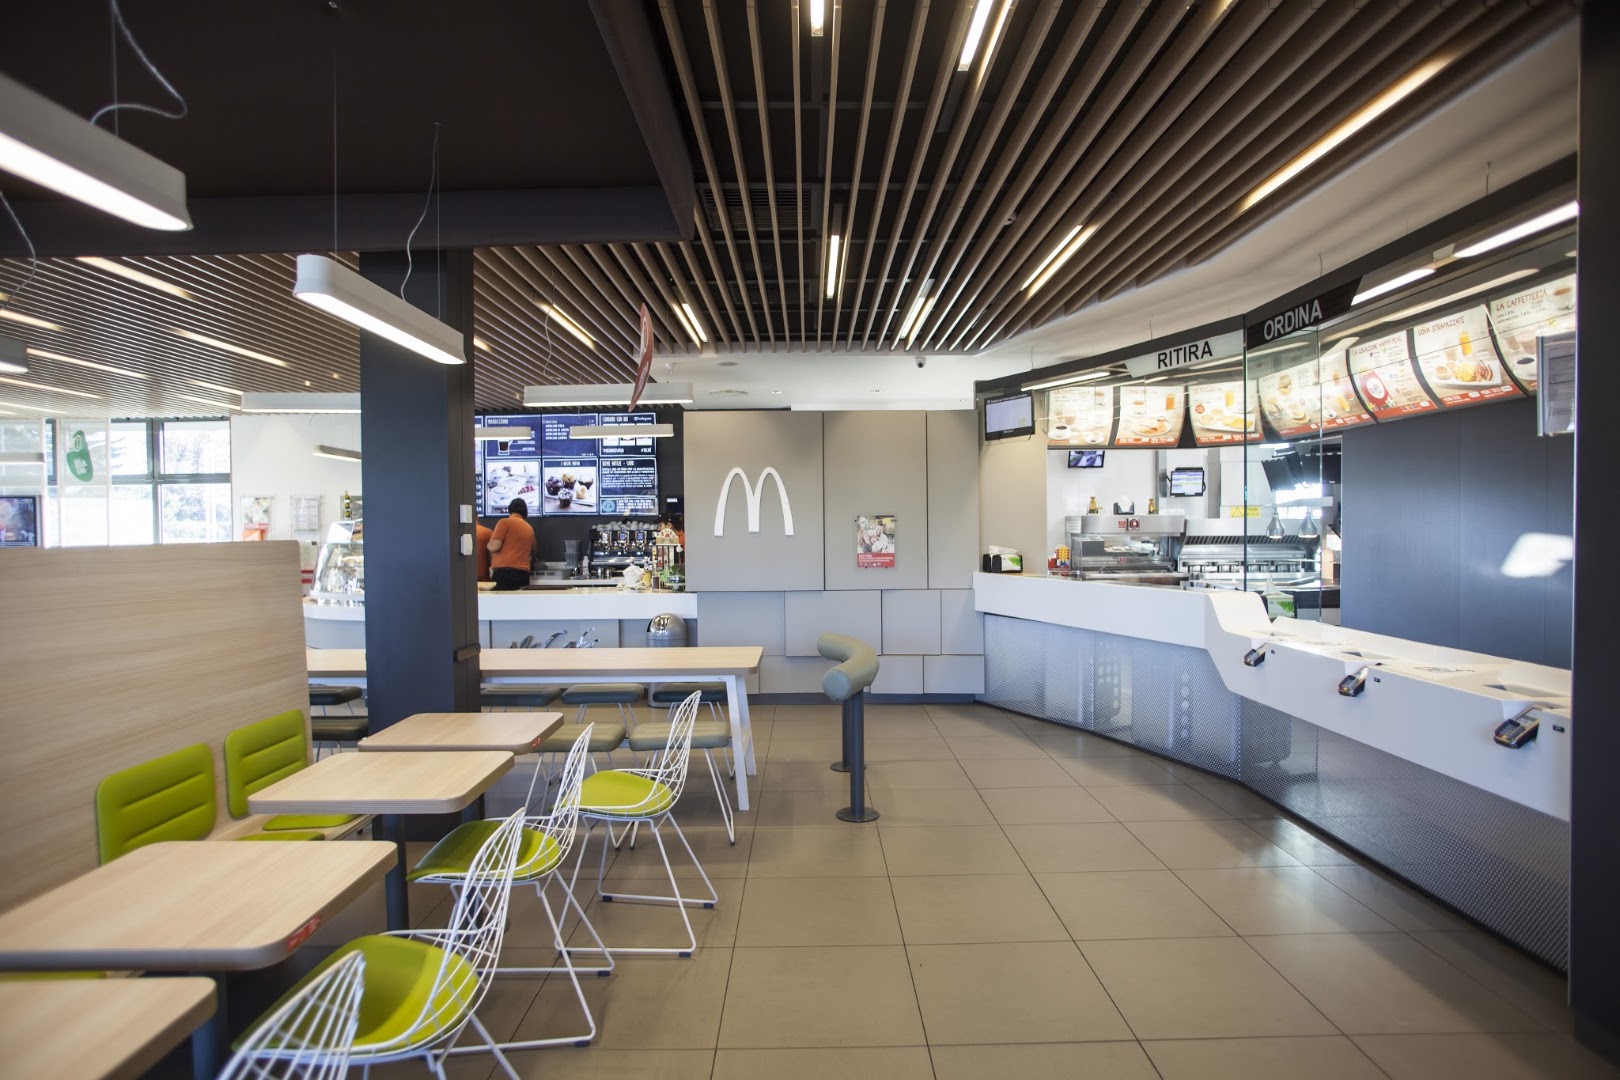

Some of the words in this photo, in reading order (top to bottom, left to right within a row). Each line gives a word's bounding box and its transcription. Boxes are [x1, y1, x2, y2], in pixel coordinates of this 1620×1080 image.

[1496, 302, 1505, 312] LA
[1506, 289, 1548, 308] CAFFETTERIA
[1264, 299, 1323, 341] ORDINA
[1417, 327, 1431, 338] UOVA
[1431, 315, 1465, 333] STRAPAZZATE
[1157, 340, 1213, 369] RITIRA
